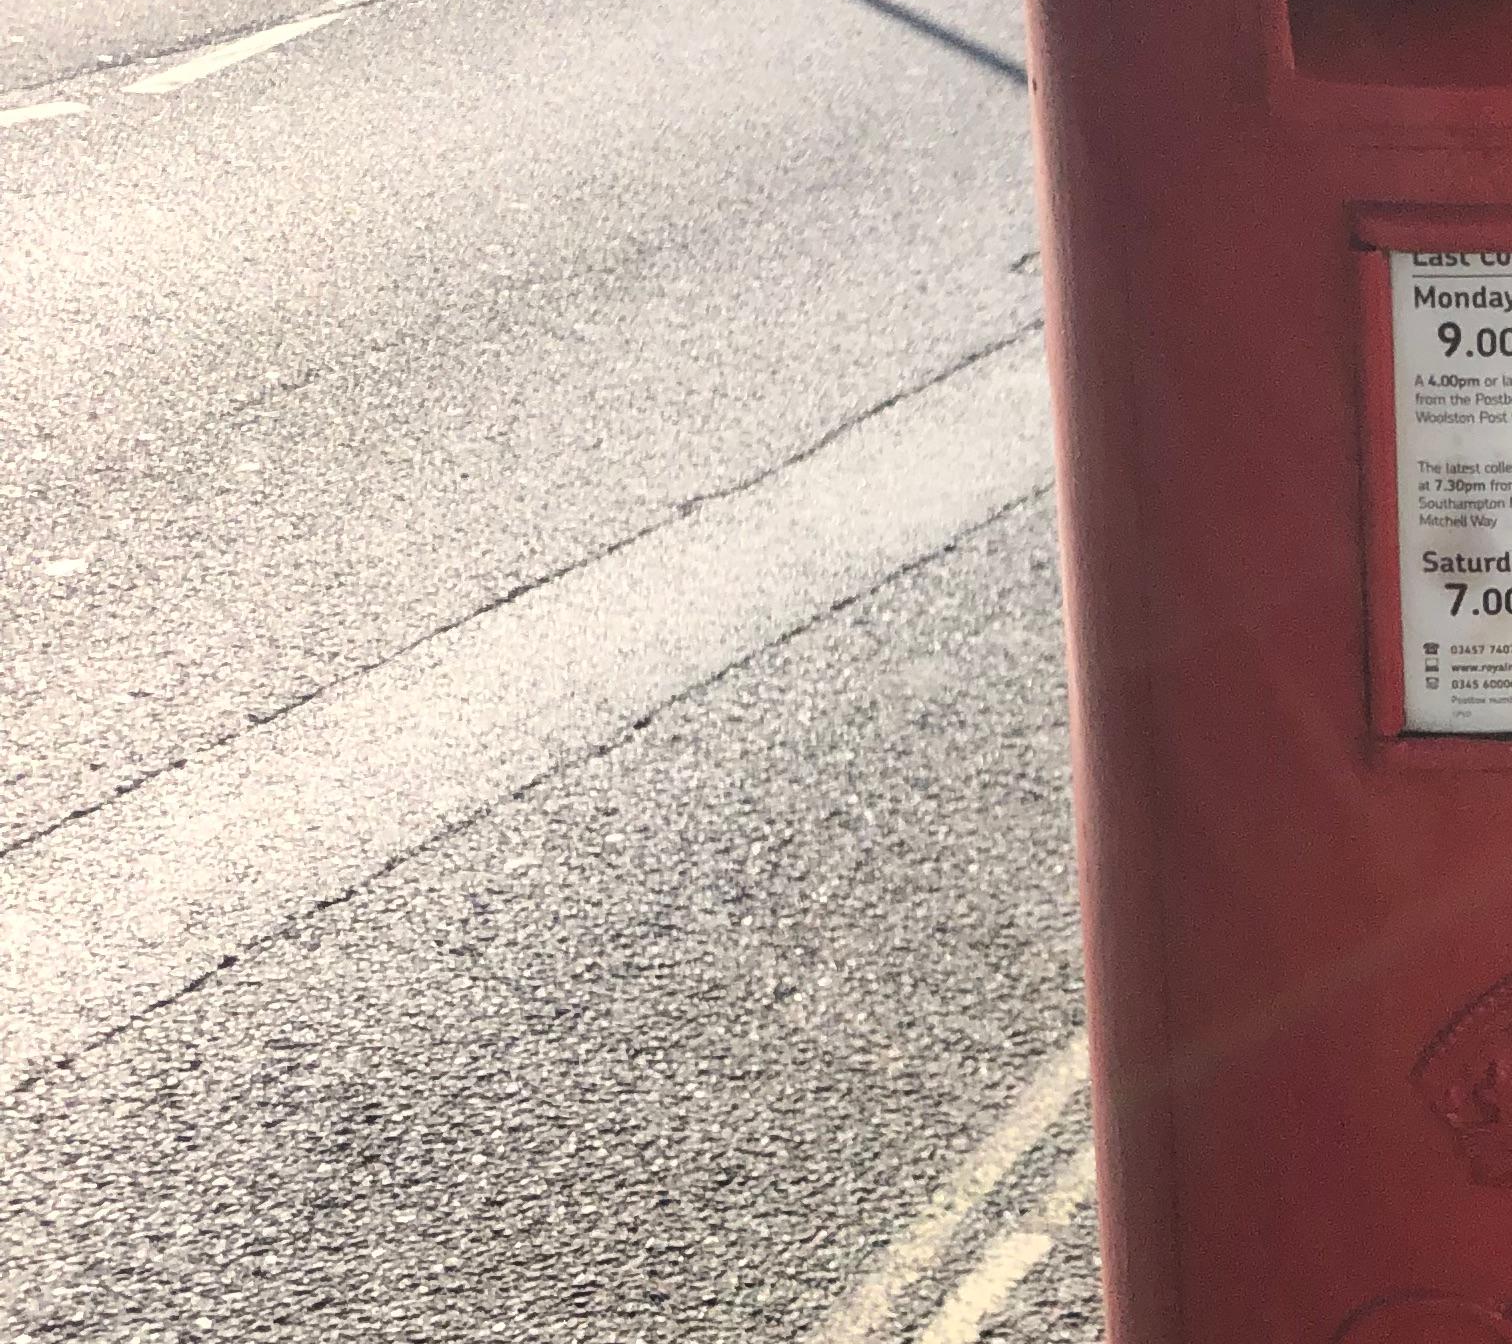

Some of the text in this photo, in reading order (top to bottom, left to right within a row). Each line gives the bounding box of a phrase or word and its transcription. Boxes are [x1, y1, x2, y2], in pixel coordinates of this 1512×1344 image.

[1415, 375, 1424, 387] A
[1428, 374, 1480, 389] 4.00pm
[1484, 376, 1498, 387] or
[1415, 393, 1446, 405] from
[1450, 394, 1471, 405] the
[1416, 411, 1475, 424] Woolston
[1479, 411, 1508, 424] Post
[1418, 460, 1441, 474] The
[1445, 462, 1480, 474] latest
[1418, 480, 1430, 492] at
[1434, 479, 1486, 494] 7.30pm
[1419, 496, 1505, 511] Southampton
[1419, 514, 1498, 529] Mitchell Way
[1450, 645, 1484, 655] 03457
[1452, 679, 1479, 690] 0345
